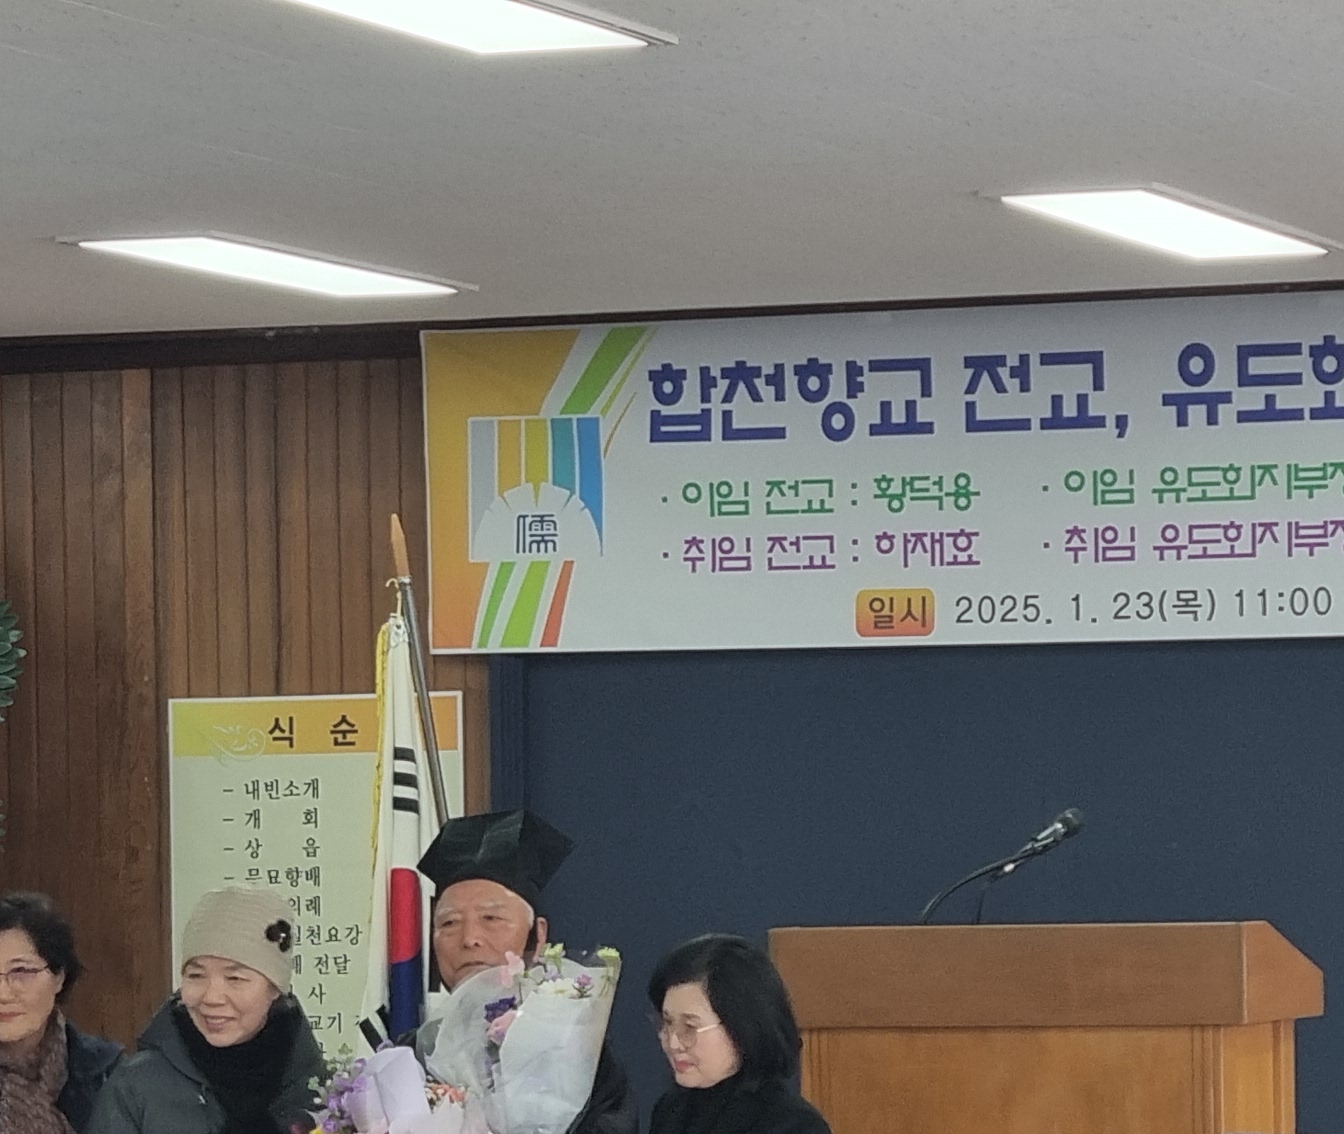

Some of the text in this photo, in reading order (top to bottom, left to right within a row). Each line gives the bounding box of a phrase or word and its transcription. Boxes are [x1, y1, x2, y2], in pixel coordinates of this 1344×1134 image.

[648, 356, 934, 443] 합천향교
[964, 351, 1128, 438] 전교,
[682, 481, 749, 517] 이임
[766, 479, 834, 515] 전교
[874, 473, 980, 513] 황덕용
[1064, 469, 1134, 506] 이임
[516, 514, 558, 553] 儒
[683, 536, 751, 573] 취임
[767, 535, 835, 570] 전교
[875, 529, 980, 568] 하재효
[1065, 526, 1135, 563] 취임
[868, 596, 929, 630] 일시
[956, 595, 1052, 624] 2025.
[1113, 589, 1215, 622] 23(목)
[1235, 587, 1331, 616] 11:00
[245, 778, 318, 800] 내빈소개
[315, 954, 350, 974] 전달
